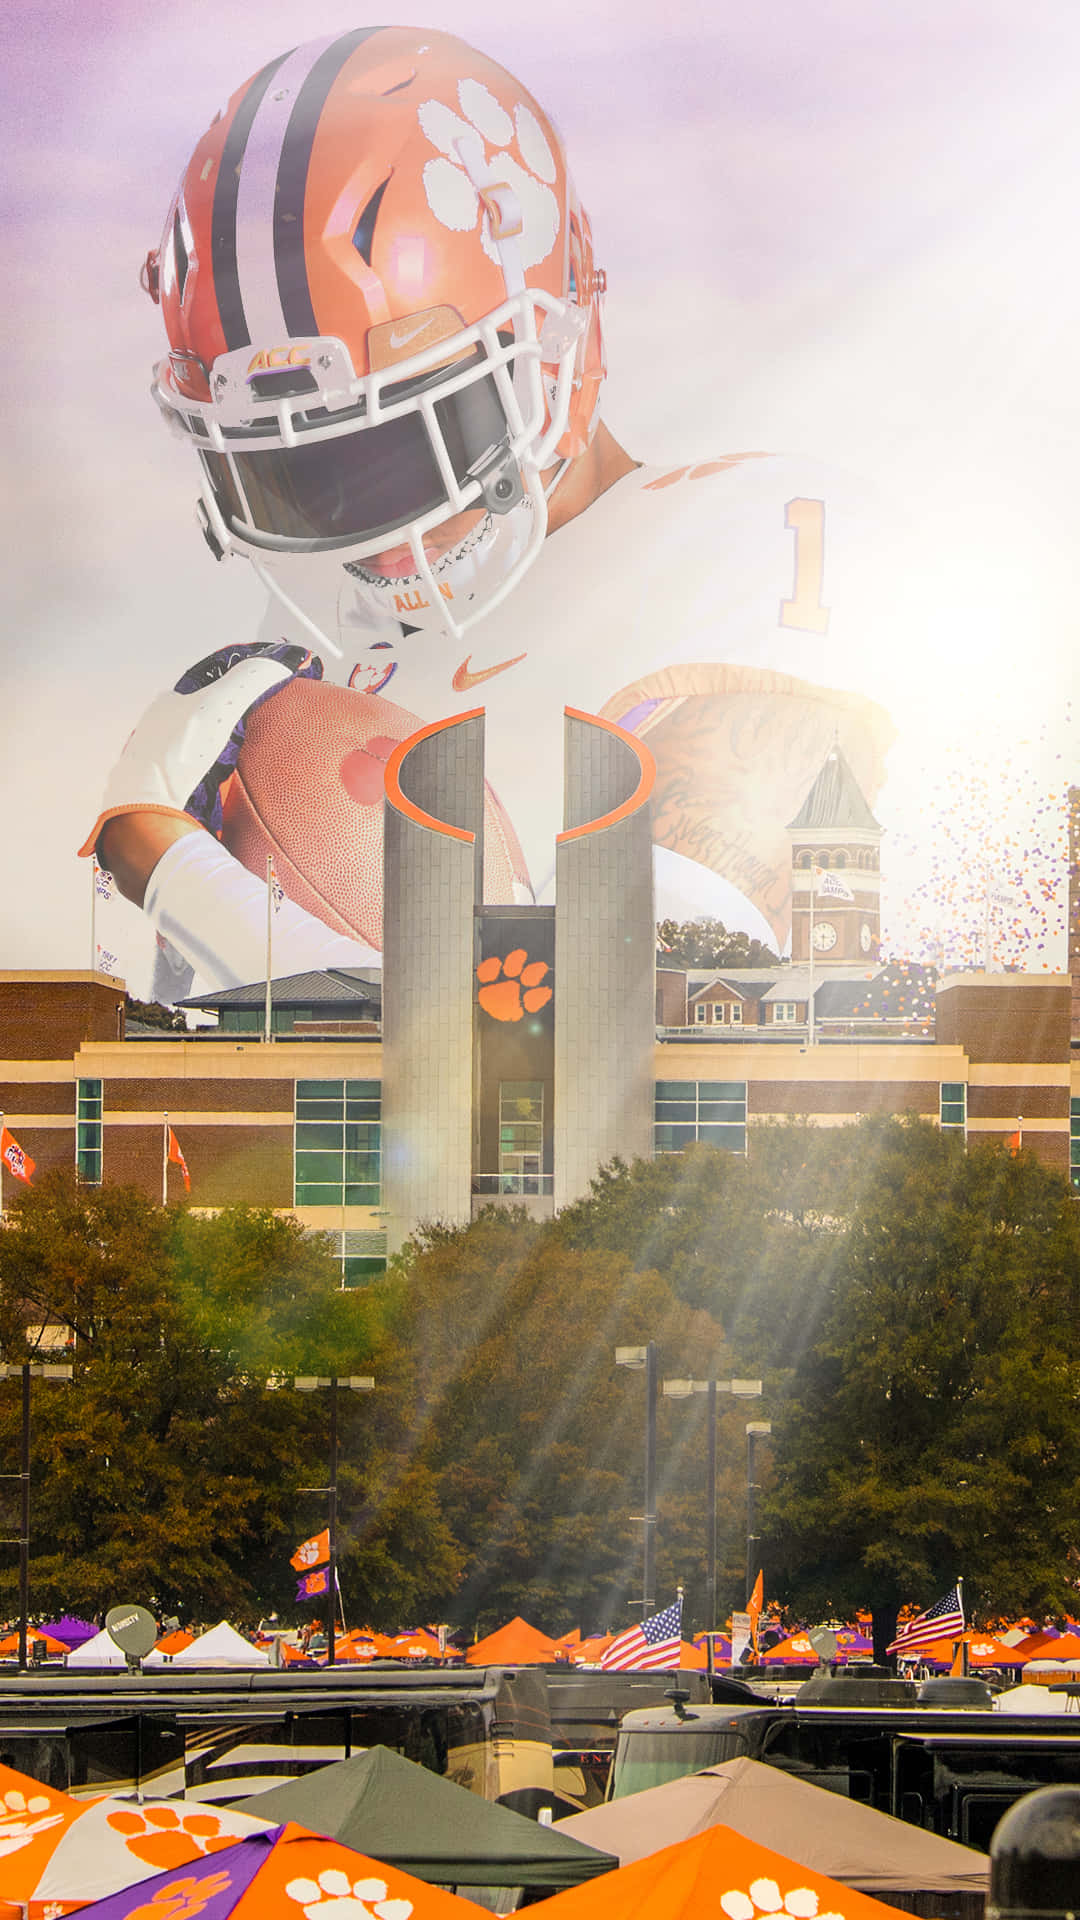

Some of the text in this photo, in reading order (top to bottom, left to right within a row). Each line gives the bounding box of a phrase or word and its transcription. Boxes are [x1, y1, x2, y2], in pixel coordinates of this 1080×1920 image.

[247, 343, 312, 373] ACC
[778, 497, 831, 633] 1
[393, 589, 430, 612] ALL
